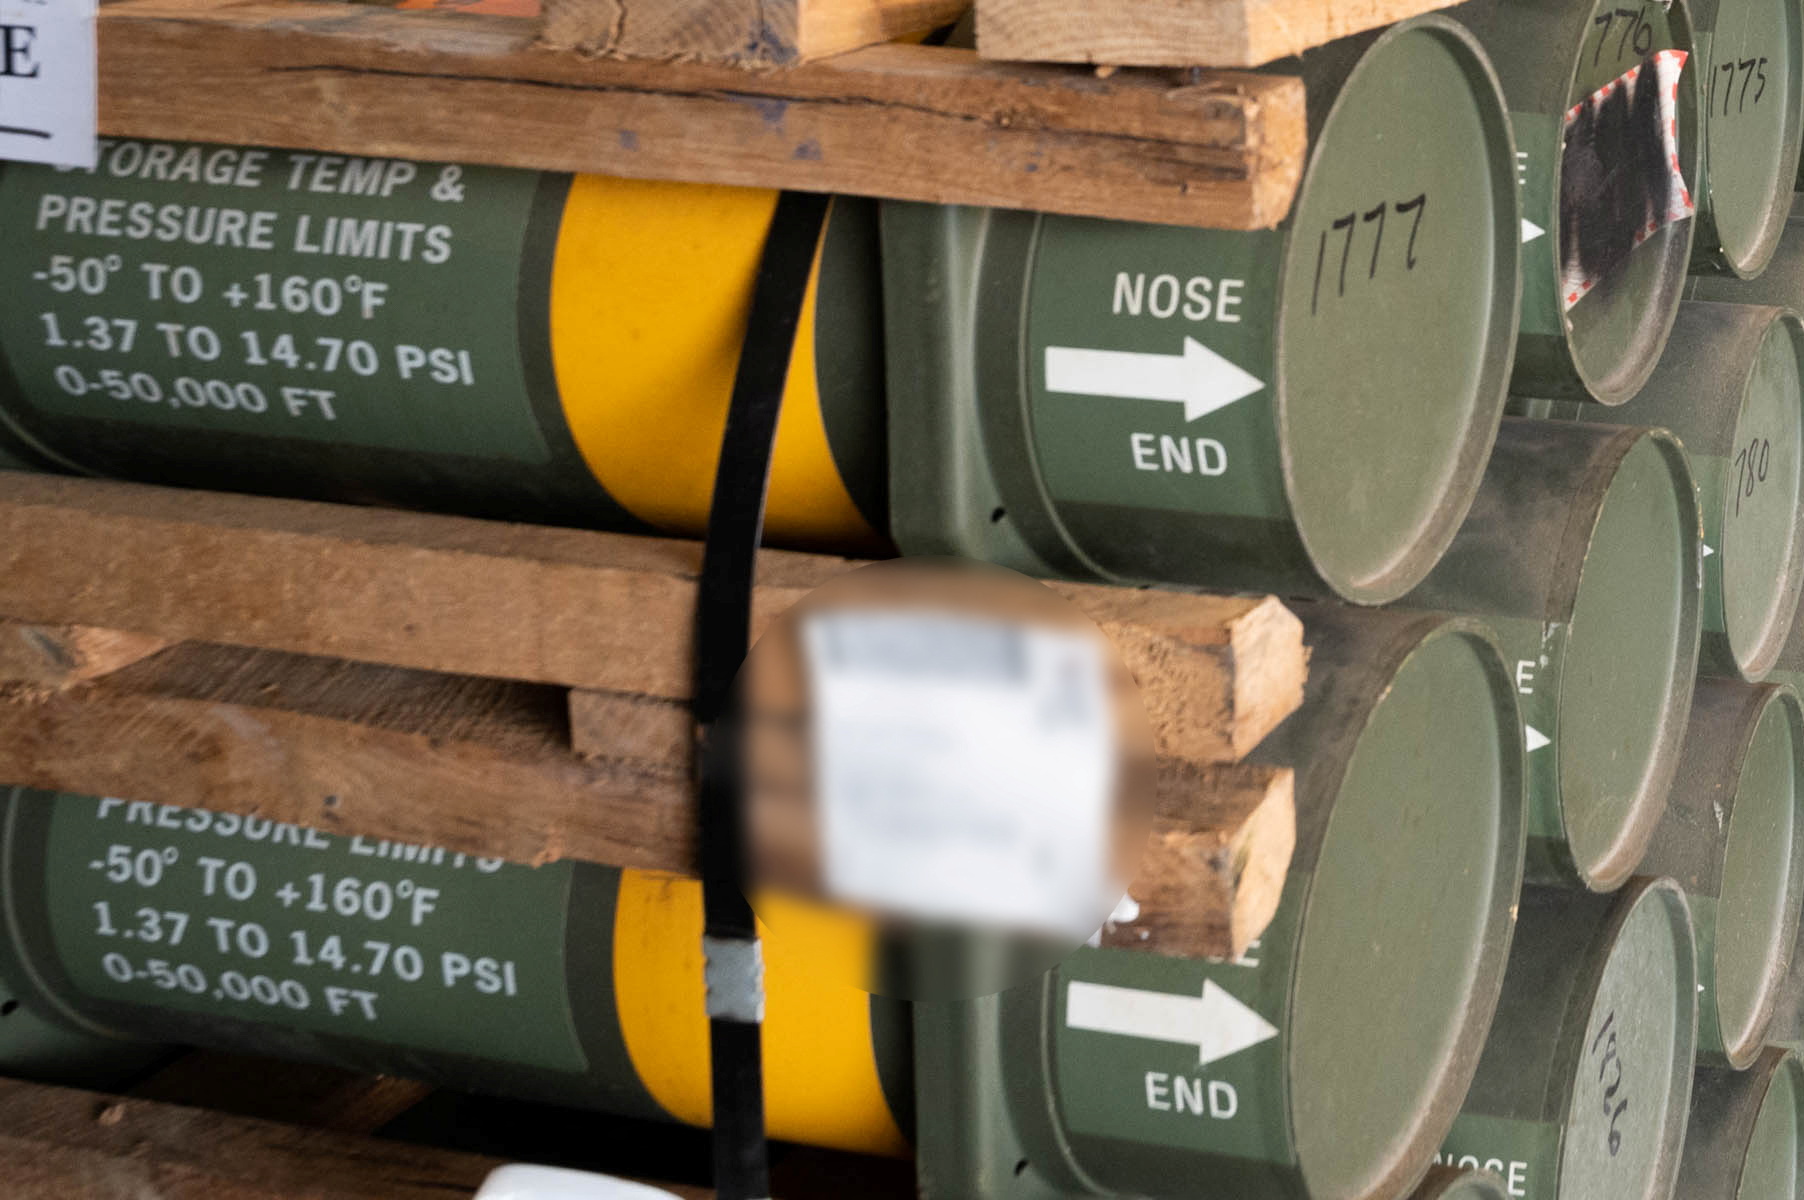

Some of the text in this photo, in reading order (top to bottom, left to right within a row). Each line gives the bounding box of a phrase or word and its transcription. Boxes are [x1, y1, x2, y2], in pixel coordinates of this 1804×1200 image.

[1710, 57, 1768, 118] 1775
[286, 154, 417, 197] TEMP
[431, 166, 466, 203] &
[36, 195, 453, 263] PRESSURE LIMITS
[1311, 193, 1426, 317] 1777
[32, 254, 389, 320] -50° TO +160°F
[1112, 272, 1245, 323] NOSE
[39, 312, 475, 385] 1.37 TO 14.70 PSI
[54, 365, 337, 420] 0-50,000 FT
[1130, 432, 1229, 477] END
[90, 845, 439, 926] -50° TO +160°F
[92, 901, 517, 996] 1.37 TO 14.70 PSI
[101, 952, 379, 1020] 0-50,000 FT
[1145, 1071, 1238, 1120] END
